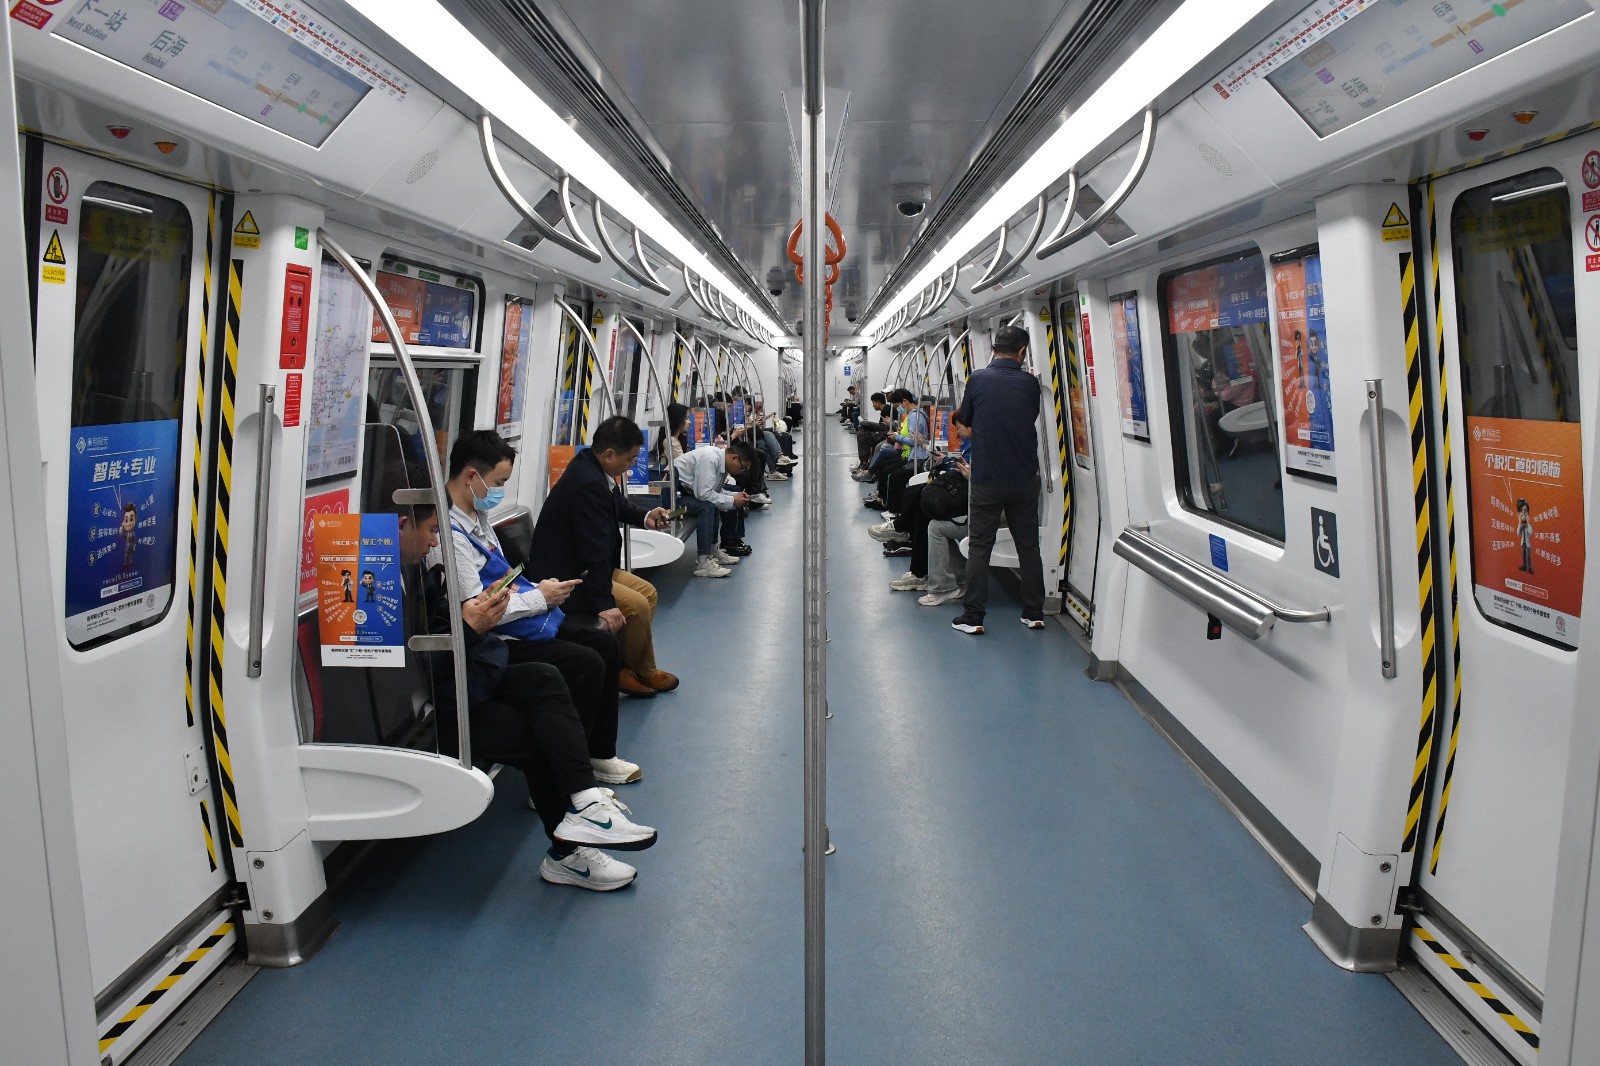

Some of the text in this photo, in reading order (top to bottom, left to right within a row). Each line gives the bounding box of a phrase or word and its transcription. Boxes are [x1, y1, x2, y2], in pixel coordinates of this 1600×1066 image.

[66, 16, 108, 41] Next Station
[77, 0, 127, 32] 下一站
[150, 29, 188, 57] 后海
[142, 52, 168, 70] Houhai
[93, 455, 157, 482] 智能+专业
[1484, 453, 1561, 478] 个税汇算的烦恼
[301, 566, 318, 580] riority
